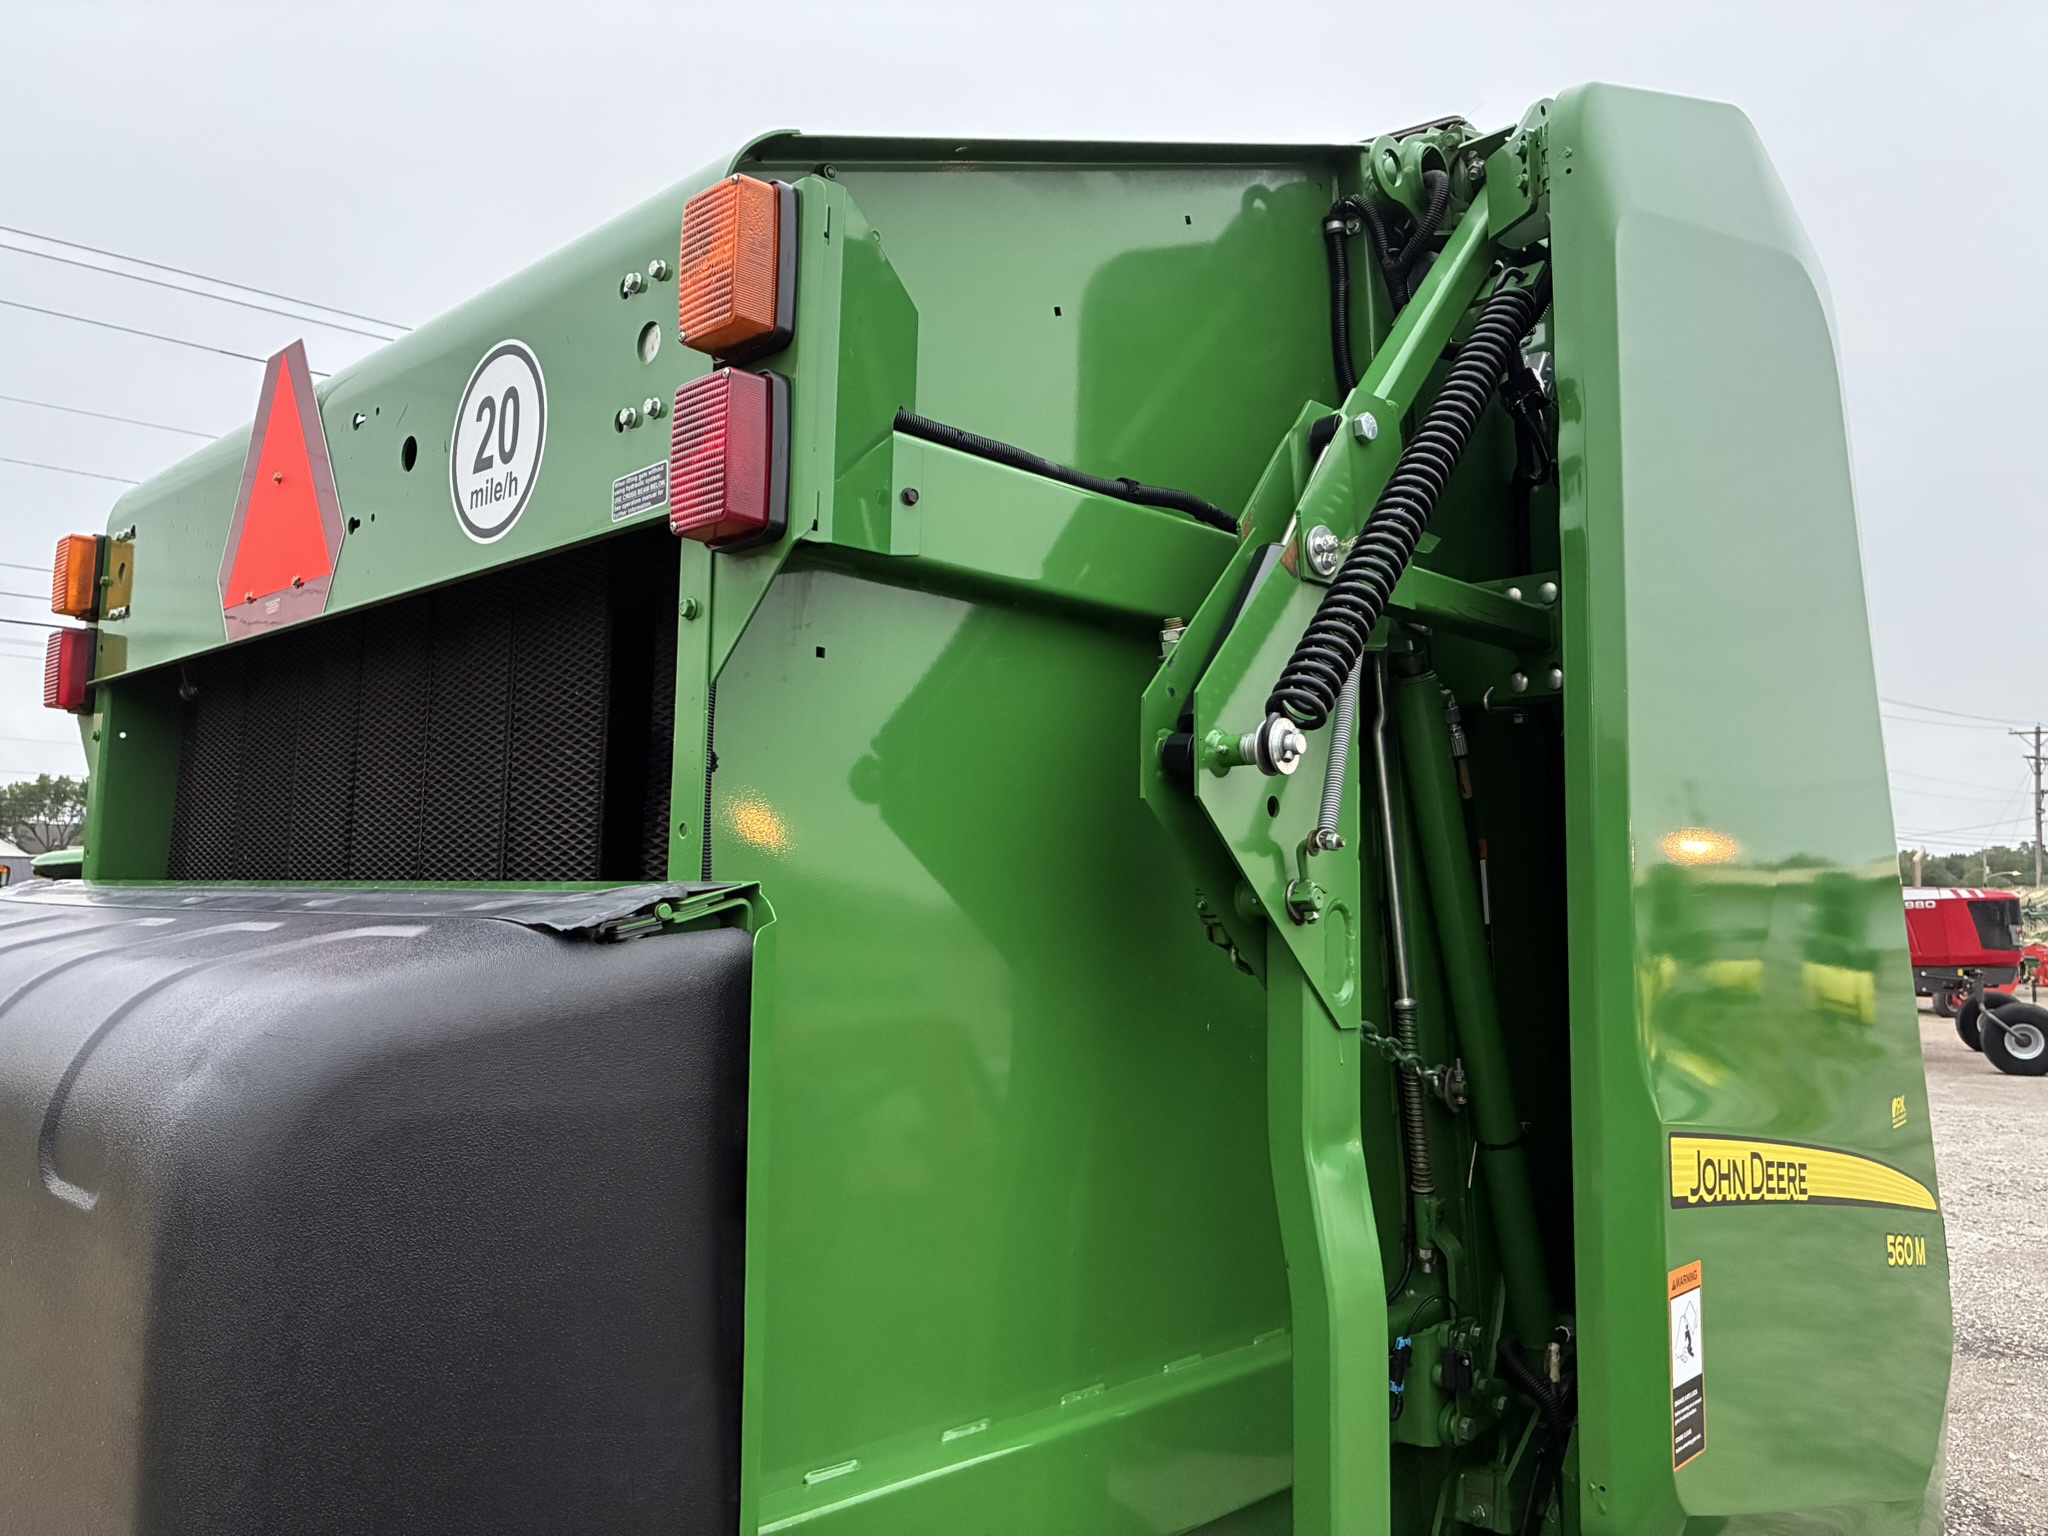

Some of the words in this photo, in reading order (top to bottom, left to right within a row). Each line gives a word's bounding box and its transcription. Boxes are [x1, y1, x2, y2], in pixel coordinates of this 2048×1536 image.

[473, 386, 520, 474] 20
[470, 471, 518, 510] mile/h
[1690, 1149, 1745, 1197] JOHN
[1750, 1151, 1808, 1196] DEERE
[1886, 1234, 1914, 1266] 560
[1914, 1235, 1927, 1266] M
